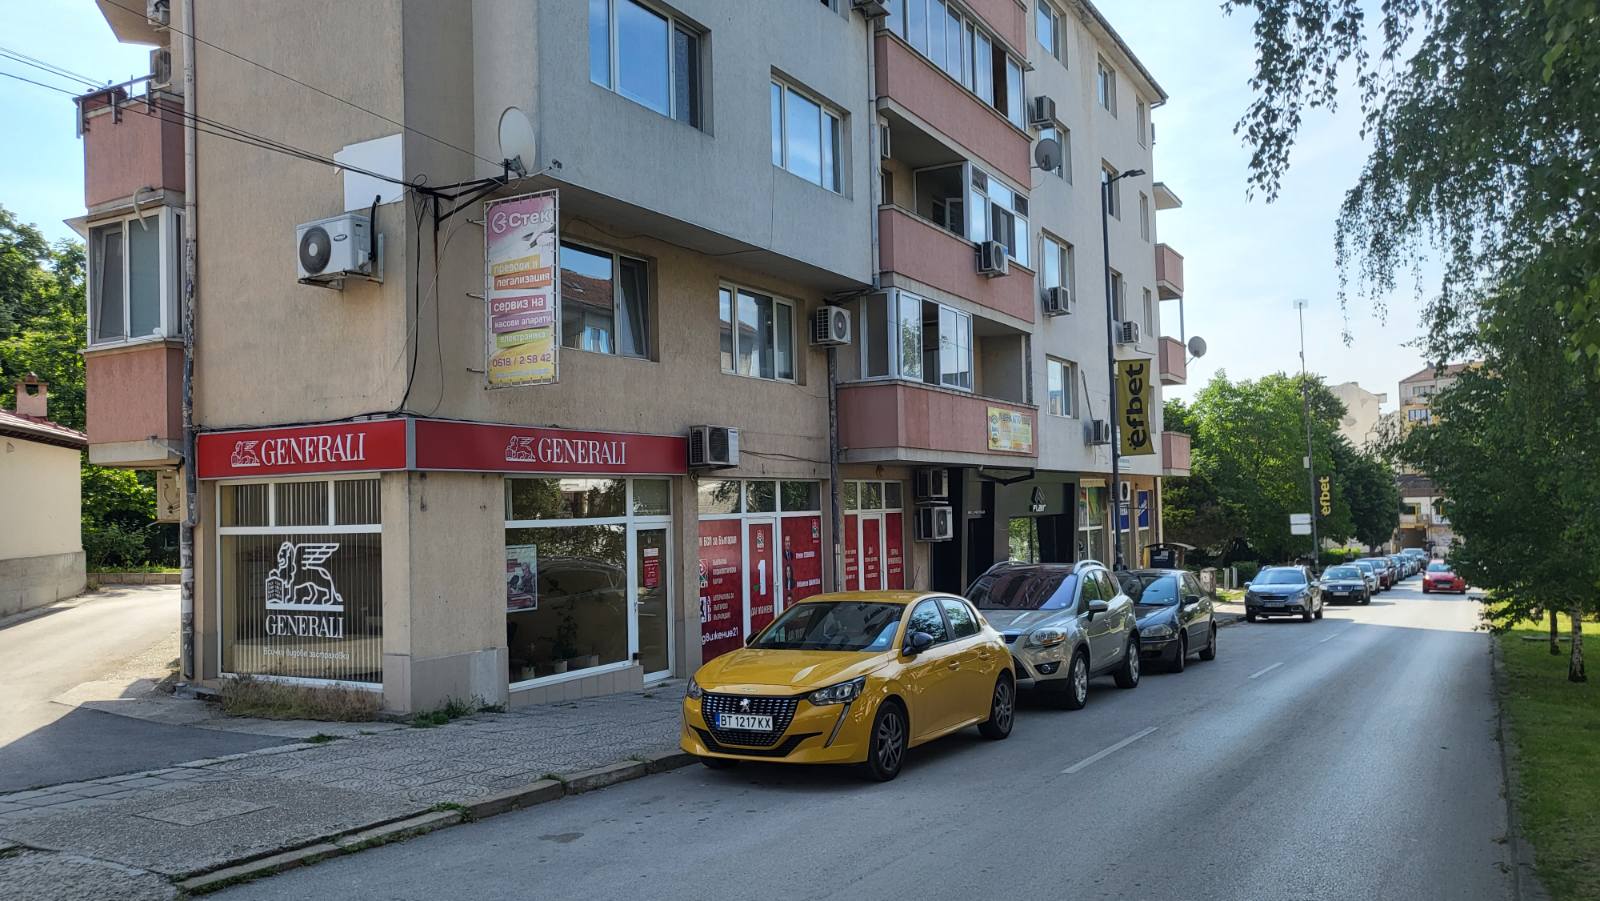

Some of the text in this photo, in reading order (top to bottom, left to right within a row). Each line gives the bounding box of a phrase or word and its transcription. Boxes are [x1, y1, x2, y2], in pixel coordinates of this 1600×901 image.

[508, 209, 551, 227] Стек
[496, 272, 550, 288] легализация
[493, 297, 544, 313] сервиз на
[494, 315, 551, 329] касови апарати
[492, 357, 512, 368] 0618
[519, 355, 525, 365] 2
[540, 353, 551, 363] 42
[1125, 363, 1147, 450] efbet
[261, 432, 366, 466] GENERALI
[537, 437, 626, 465] GENERALI
[1318, 476, 1331, 516] efbet
[757, 559, 766, 595] 1
[265, 614, 344, 639] GENERALI
[720, 715, 771, 729] BT 1217 KX
